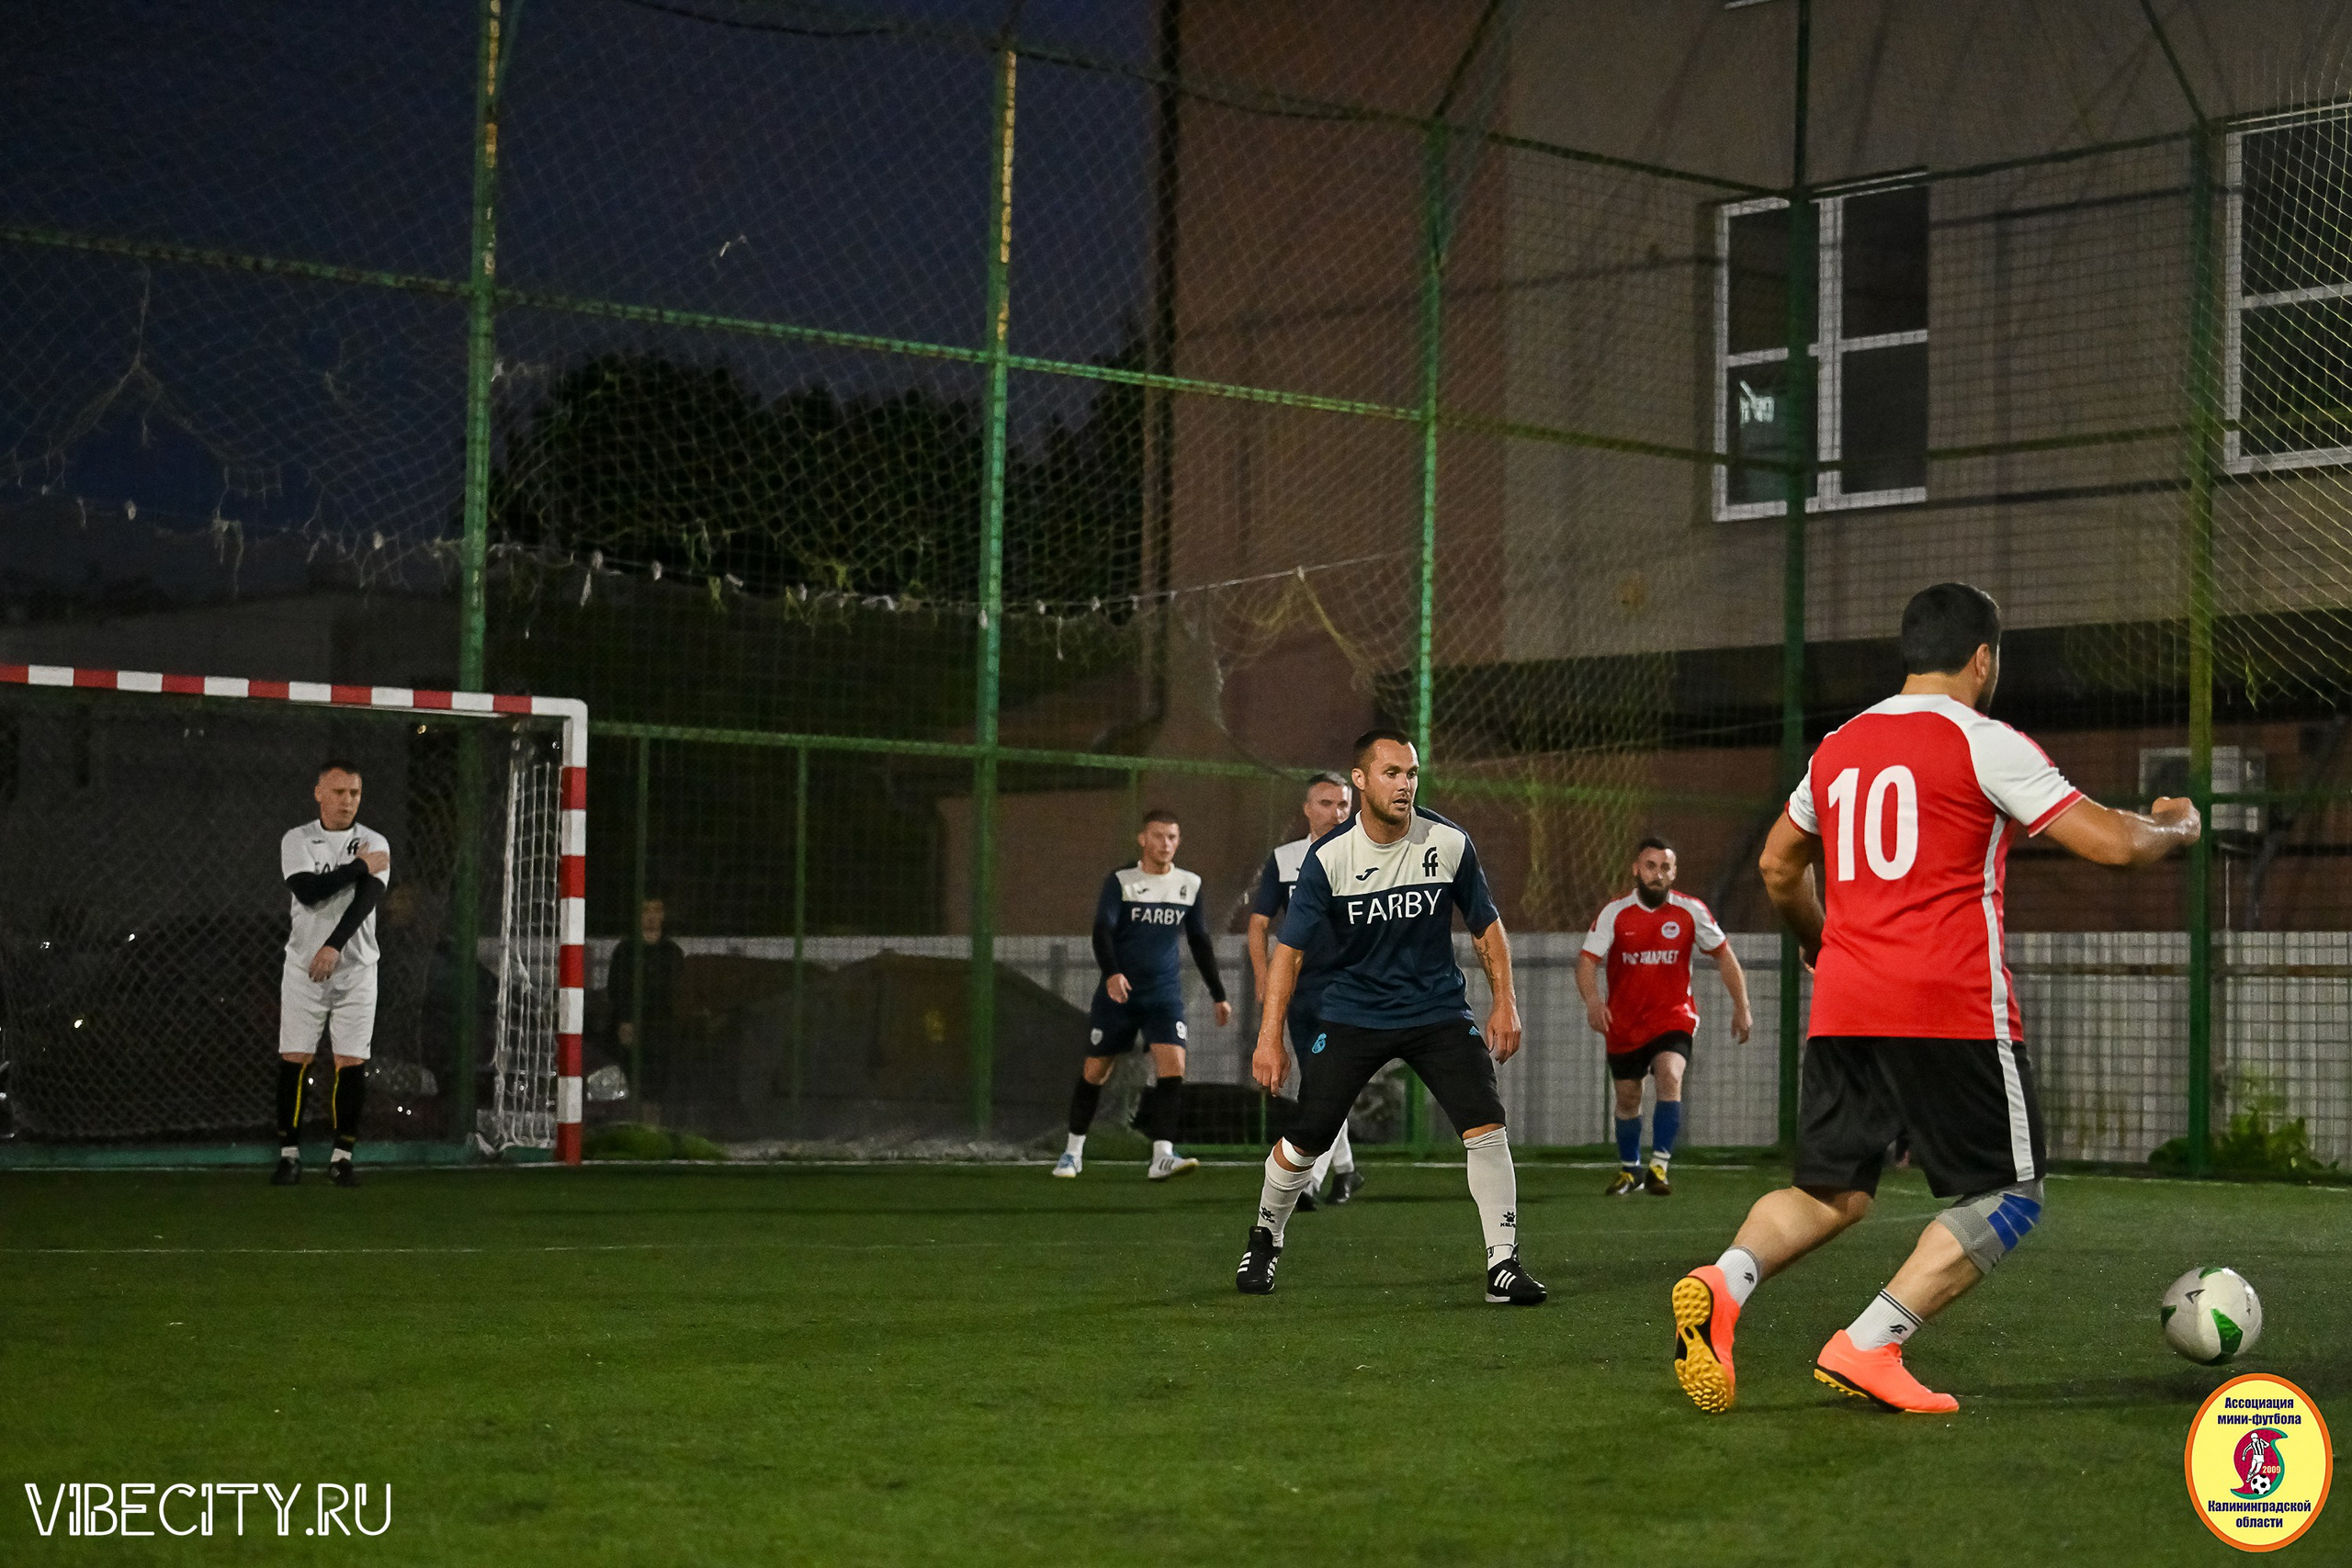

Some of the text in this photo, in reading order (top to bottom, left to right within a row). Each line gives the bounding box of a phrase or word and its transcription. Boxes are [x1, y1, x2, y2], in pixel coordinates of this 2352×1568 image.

[1827, 764, 1918, 882] 10
[1131, 907, 1185, 926] FARBY
[1347, 888, 1442, 925] FARBY
